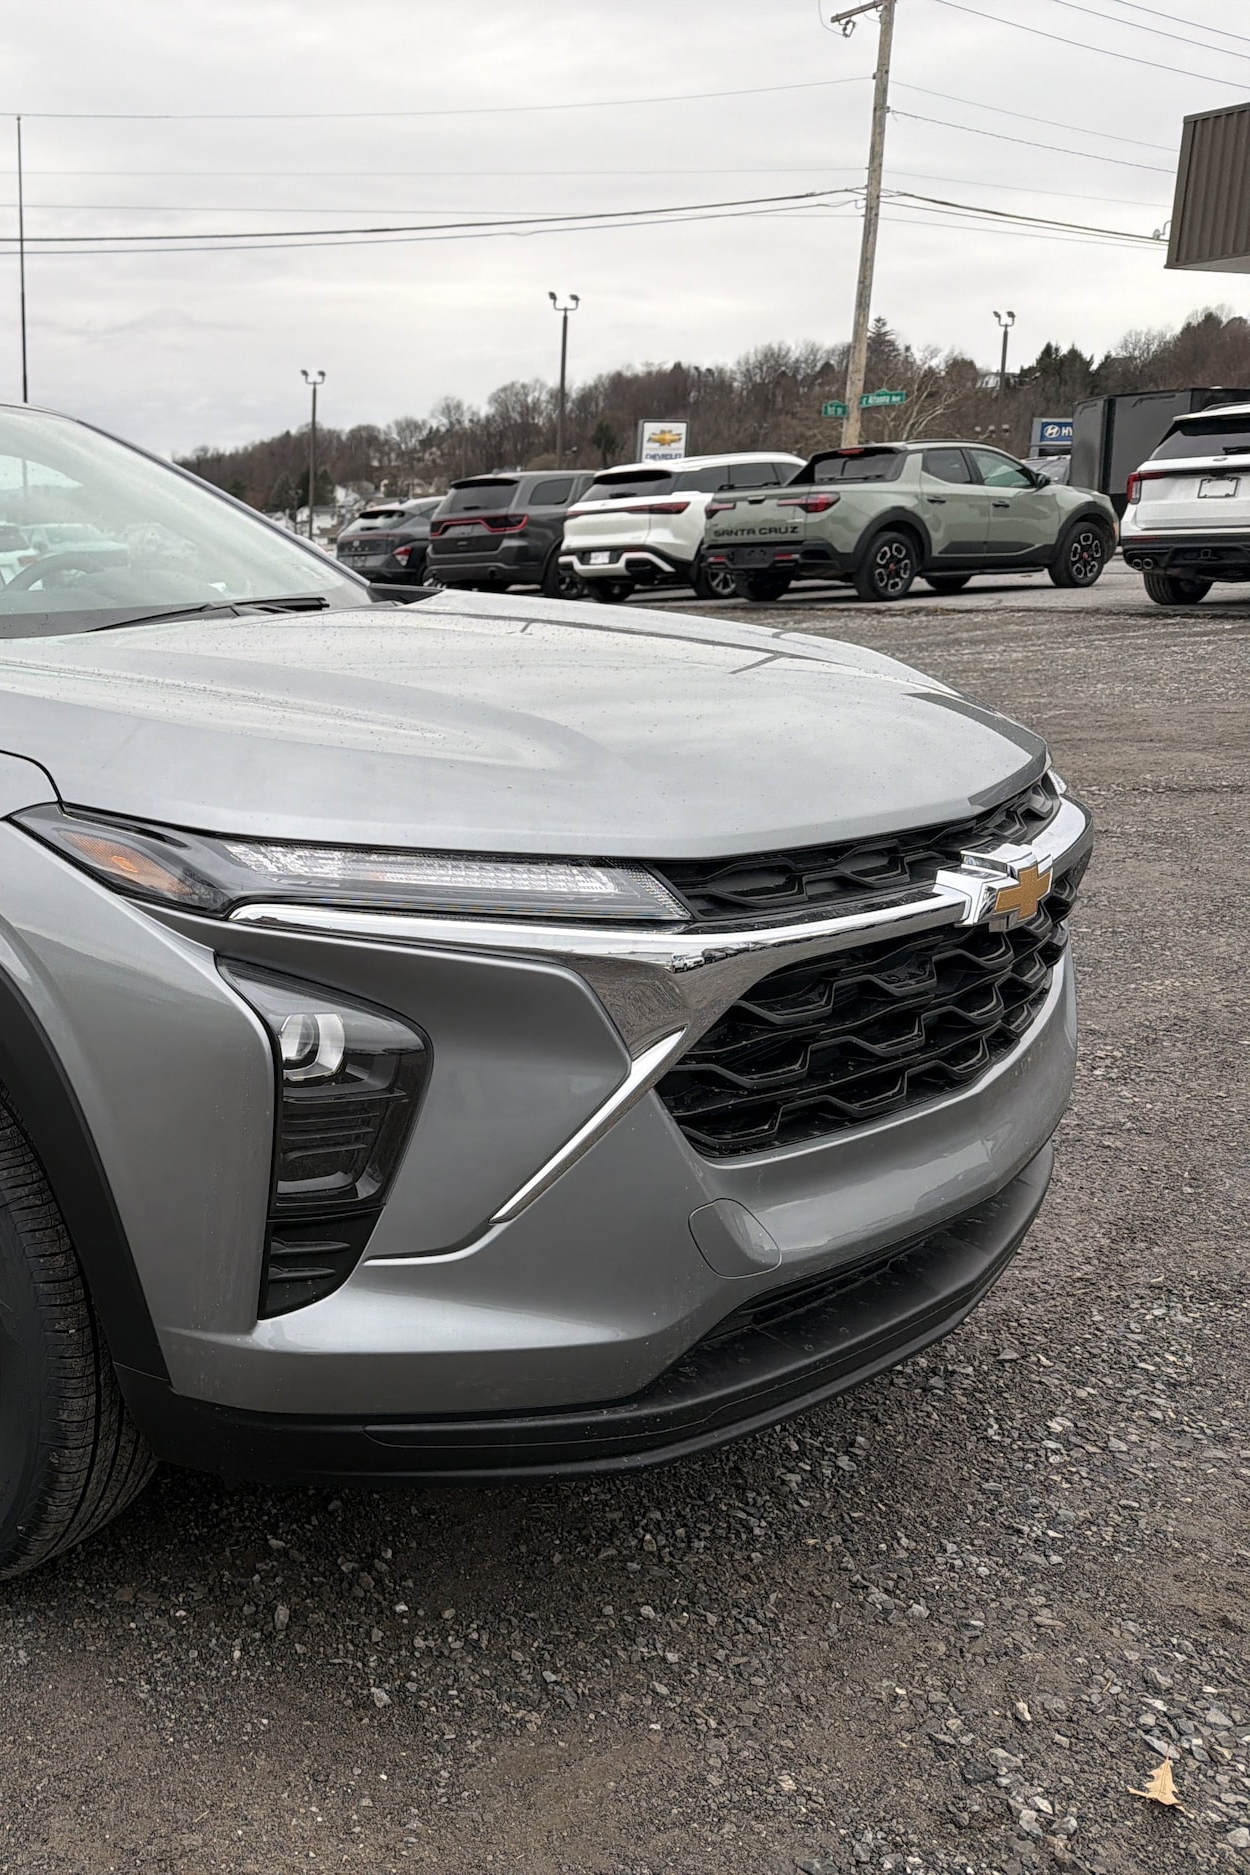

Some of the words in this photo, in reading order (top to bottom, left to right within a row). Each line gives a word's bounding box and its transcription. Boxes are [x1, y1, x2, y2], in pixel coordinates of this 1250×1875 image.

[645, 453, 683, 461] CHEVROLET
[713, 528, 756, 538] SANTA
[758, 526, 800, 536] CRUZ
